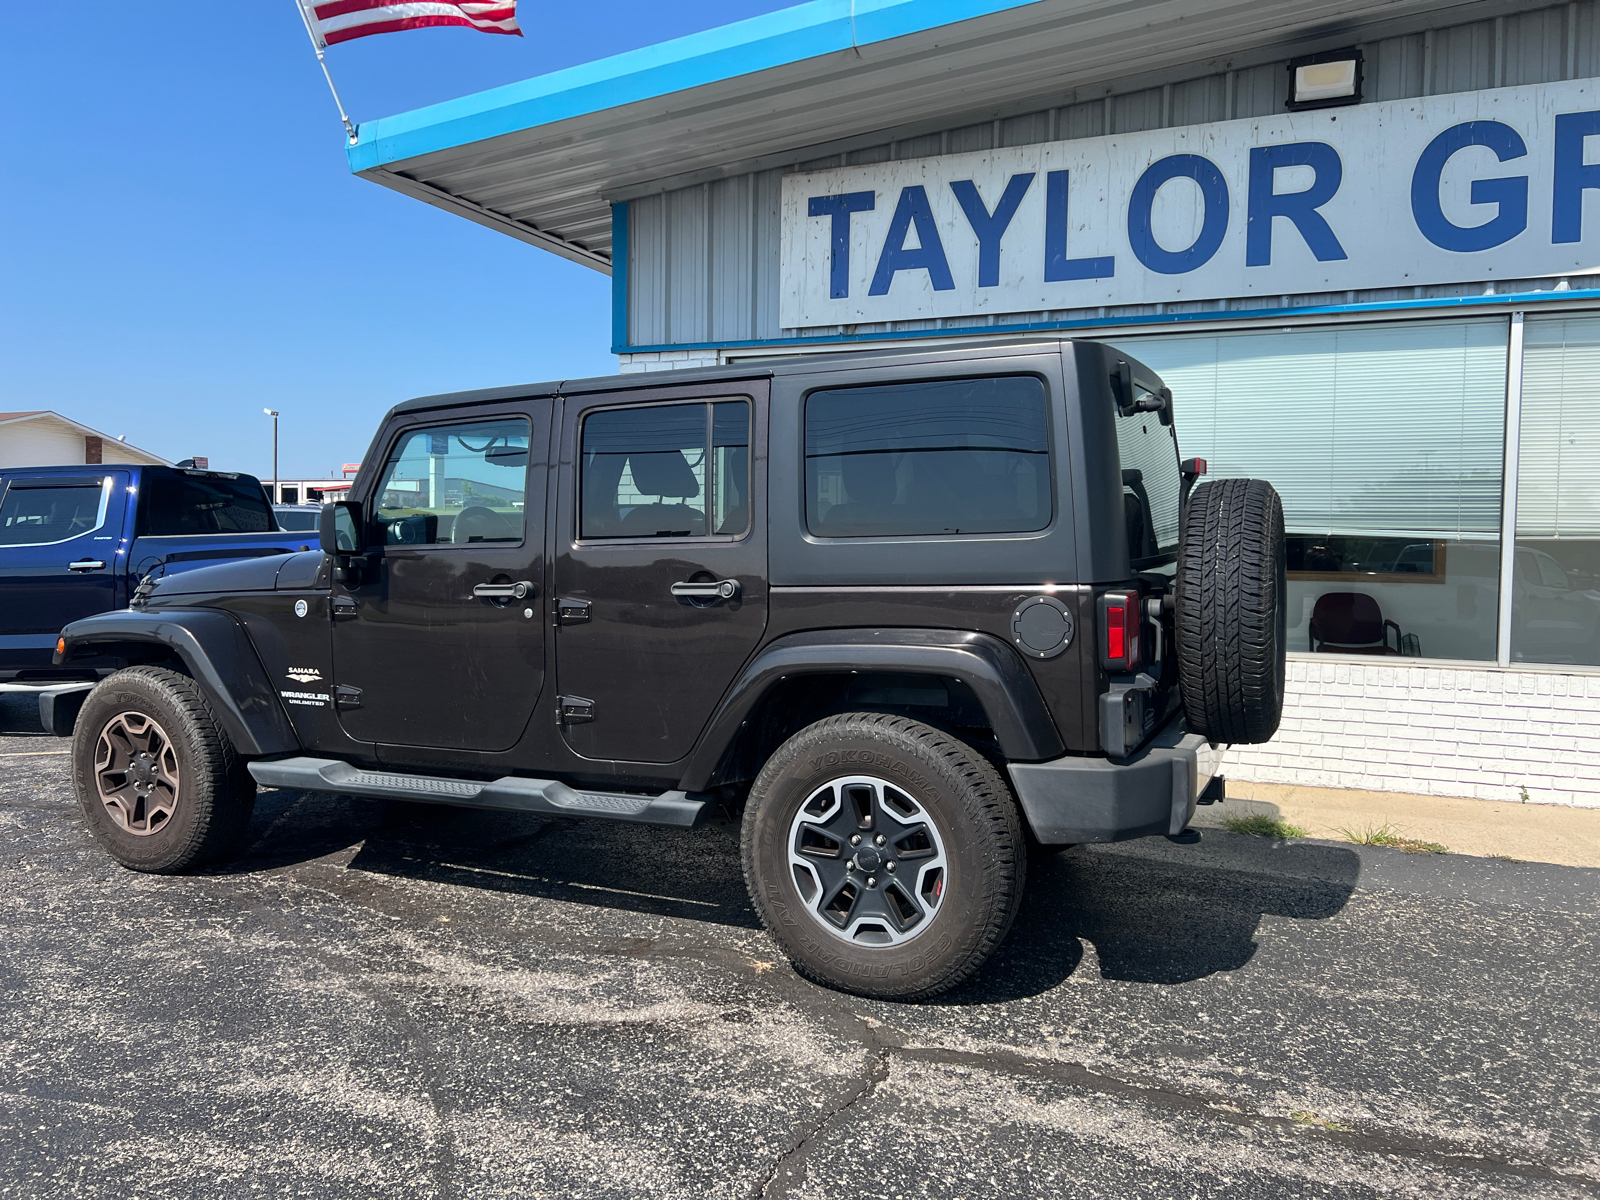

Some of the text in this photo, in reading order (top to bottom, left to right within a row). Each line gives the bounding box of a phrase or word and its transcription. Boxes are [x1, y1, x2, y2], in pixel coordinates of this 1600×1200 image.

[808, 140, 1348, 299] TAYLOR
[1040, 627, 1061, 637] Jeep
[281, 690, 330, 701] WRANGLER
[288, 667, 320, 675] SAHARA
[115, 691, 183, 751] YOKOHAMA
[808, 748, 943, 804] YOKOHAMA
[802, 930, 954, 980] GEOLANDAR
